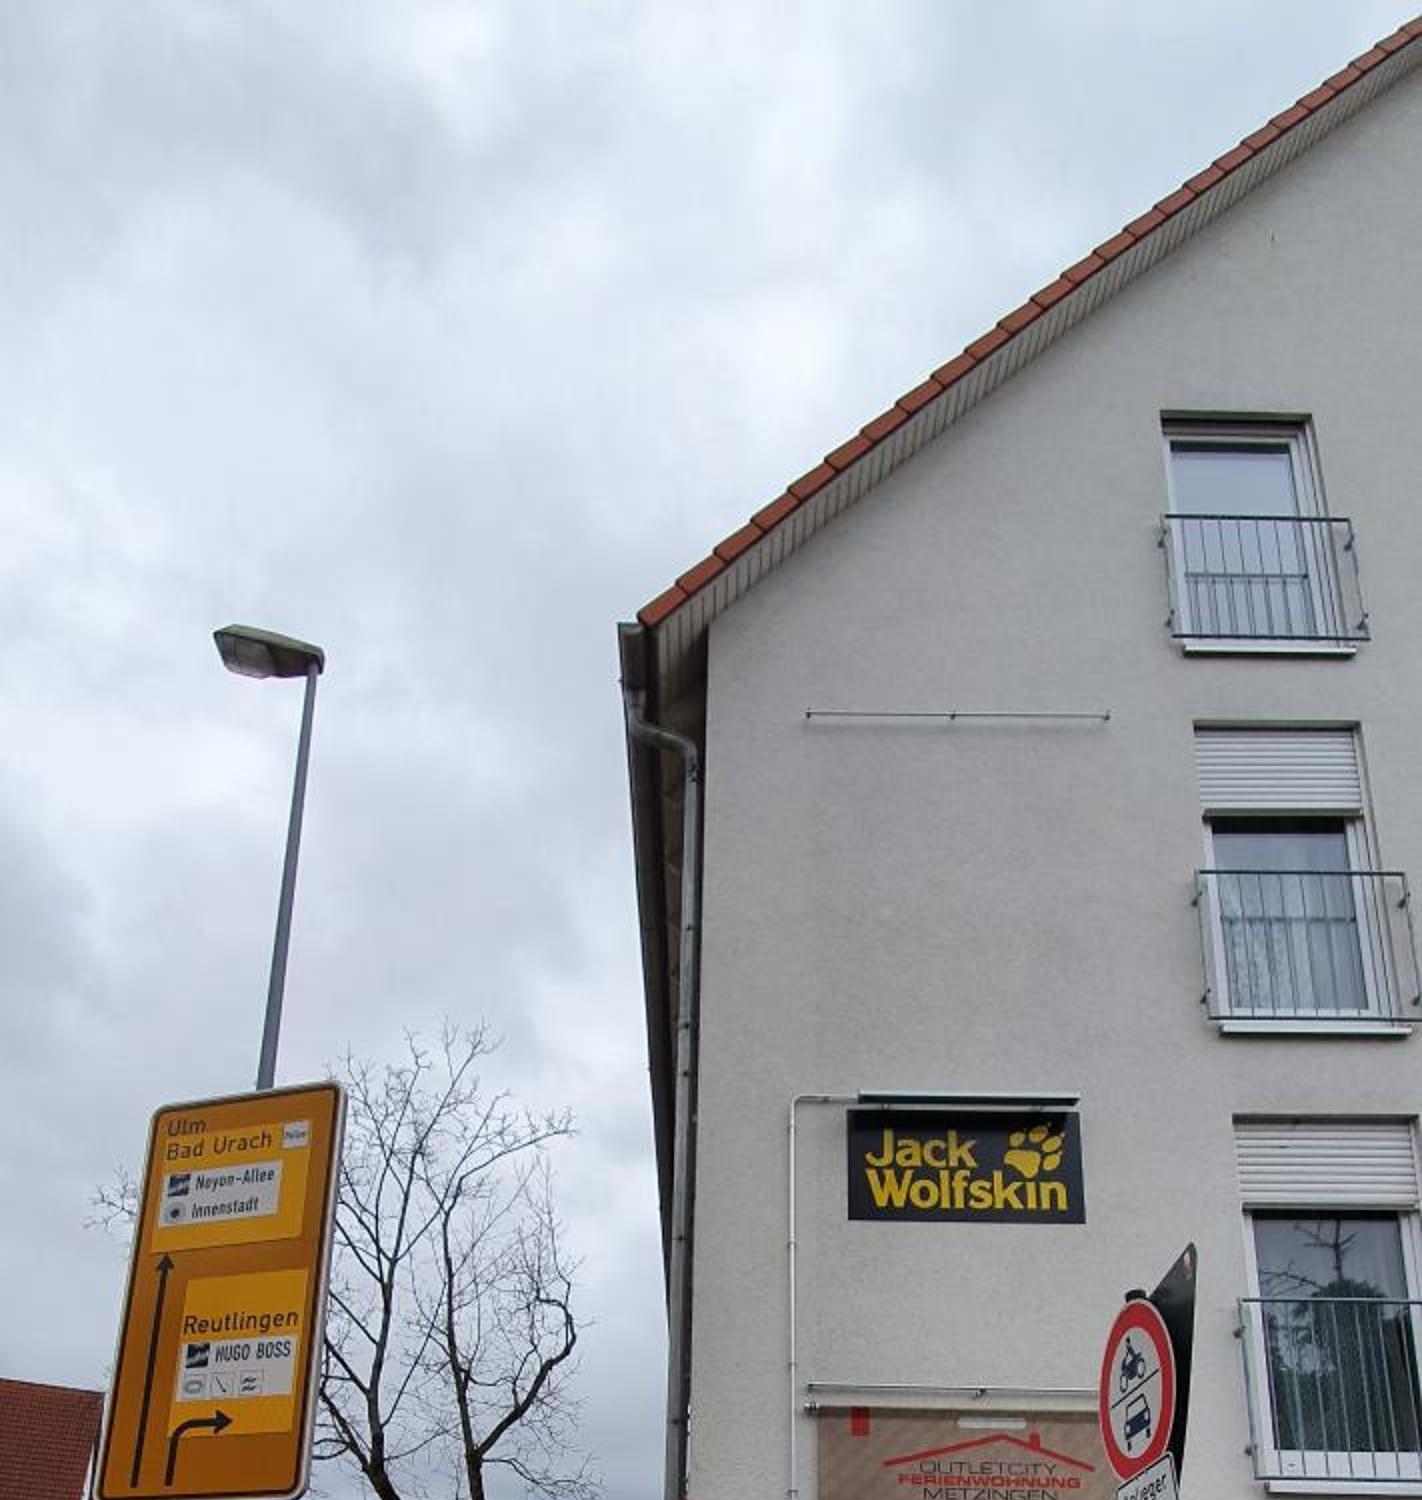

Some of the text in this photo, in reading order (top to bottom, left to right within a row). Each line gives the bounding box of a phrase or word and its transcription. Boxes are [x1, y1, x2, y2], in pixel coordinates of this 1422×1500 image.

[167, 1119, 206, 1136] Ulm
[166, 1139, 205, 1160] Bad
[213, 1129, 272, 1154] Urach
[865, 1129, 978, 1167] Jack
[195, 1168, 275, 1191] Noyon-Allee
[865, 1168, 1069, 1210] Wolfskin
[191, 1196, 260, 1218] Innenstadt
[183, 1311, 299, 1335] Reutlingen
[215, 1340, 292, 1362] HUGO BOSS
[919, 1460, 1058, 1476] OUTLETCITY
[896, 1473, 1083, 1489] FERIENWOHNUNG
